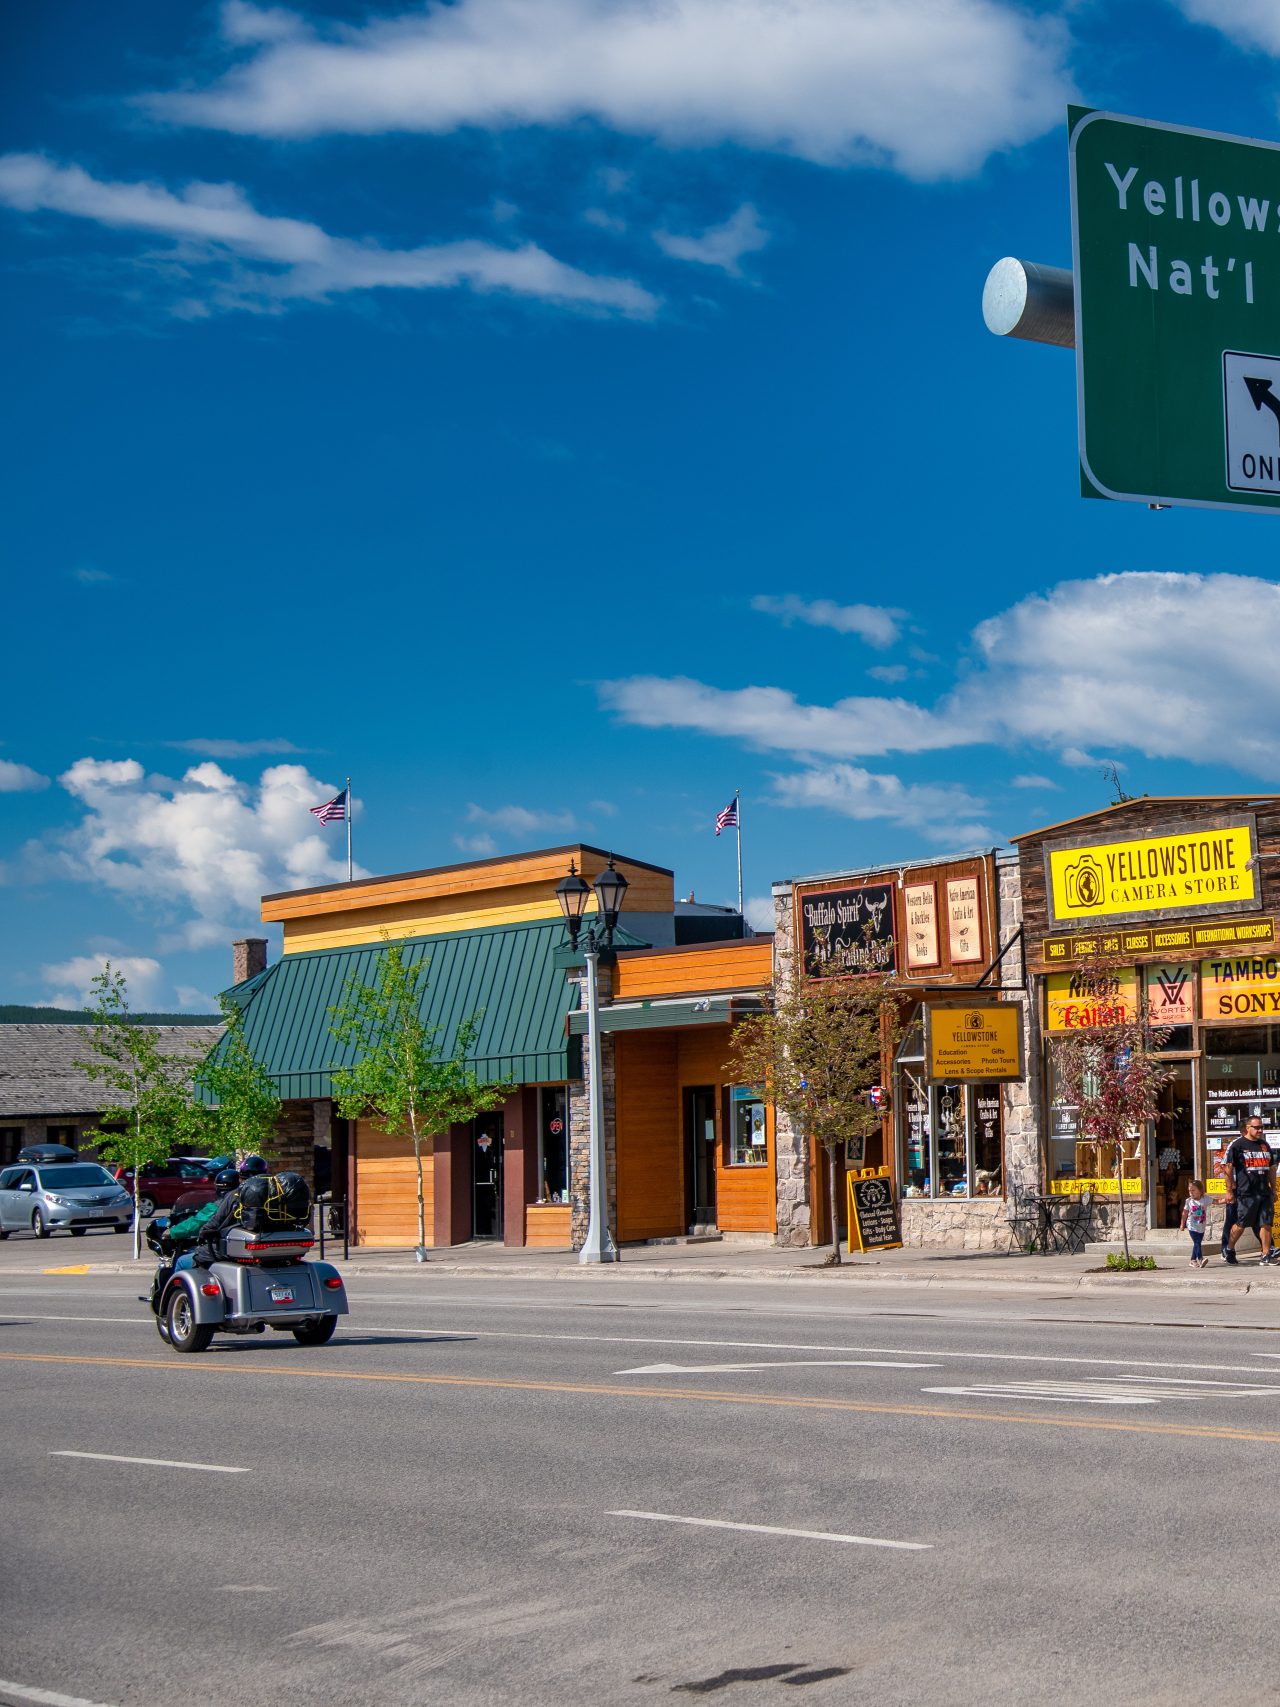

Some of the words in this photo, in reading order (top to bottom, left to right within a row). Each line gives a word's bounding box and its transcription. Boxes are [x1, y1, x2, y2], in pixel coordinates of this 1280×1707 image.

[1127, 242, 1254, 304] Nat'l
[1106, 838, 1236, 883] YELLOWSTONE
[1111, 884, 1178, 903] CAMERA
[1184, 875, 1240, 895] STORE
[804, 900, 836, 927] Buffalo
[837, 894, 863, 929] Spirit
[1049, 943, 1066, 957] SALES
[1126, 936, 1149, 950] CLASSES
[1155, 931, 1190, 947] ACCESSORIES
[1196, 926, 1236, 943] INTERNATIONAL
[1236, 923, 1272, 939] WORKSHOPS
[1154, 1006, 1192, 1014] VORTEX
[952, 1031, 998, 1042] YELLOWSTONE
[966, 1067, 985, 1075] Scope
[1208, 1090, 1218, 1098] The
[1218, 1089, 1239, 1097] Nation's
[1239, 1088, 1256, 1096] Leader
[1262, 1087, 1278, 1095] Photo
[1110, 1181, 1140, 1191] GALERY
[1208, 1181, 1227, 1191] GIFTS
